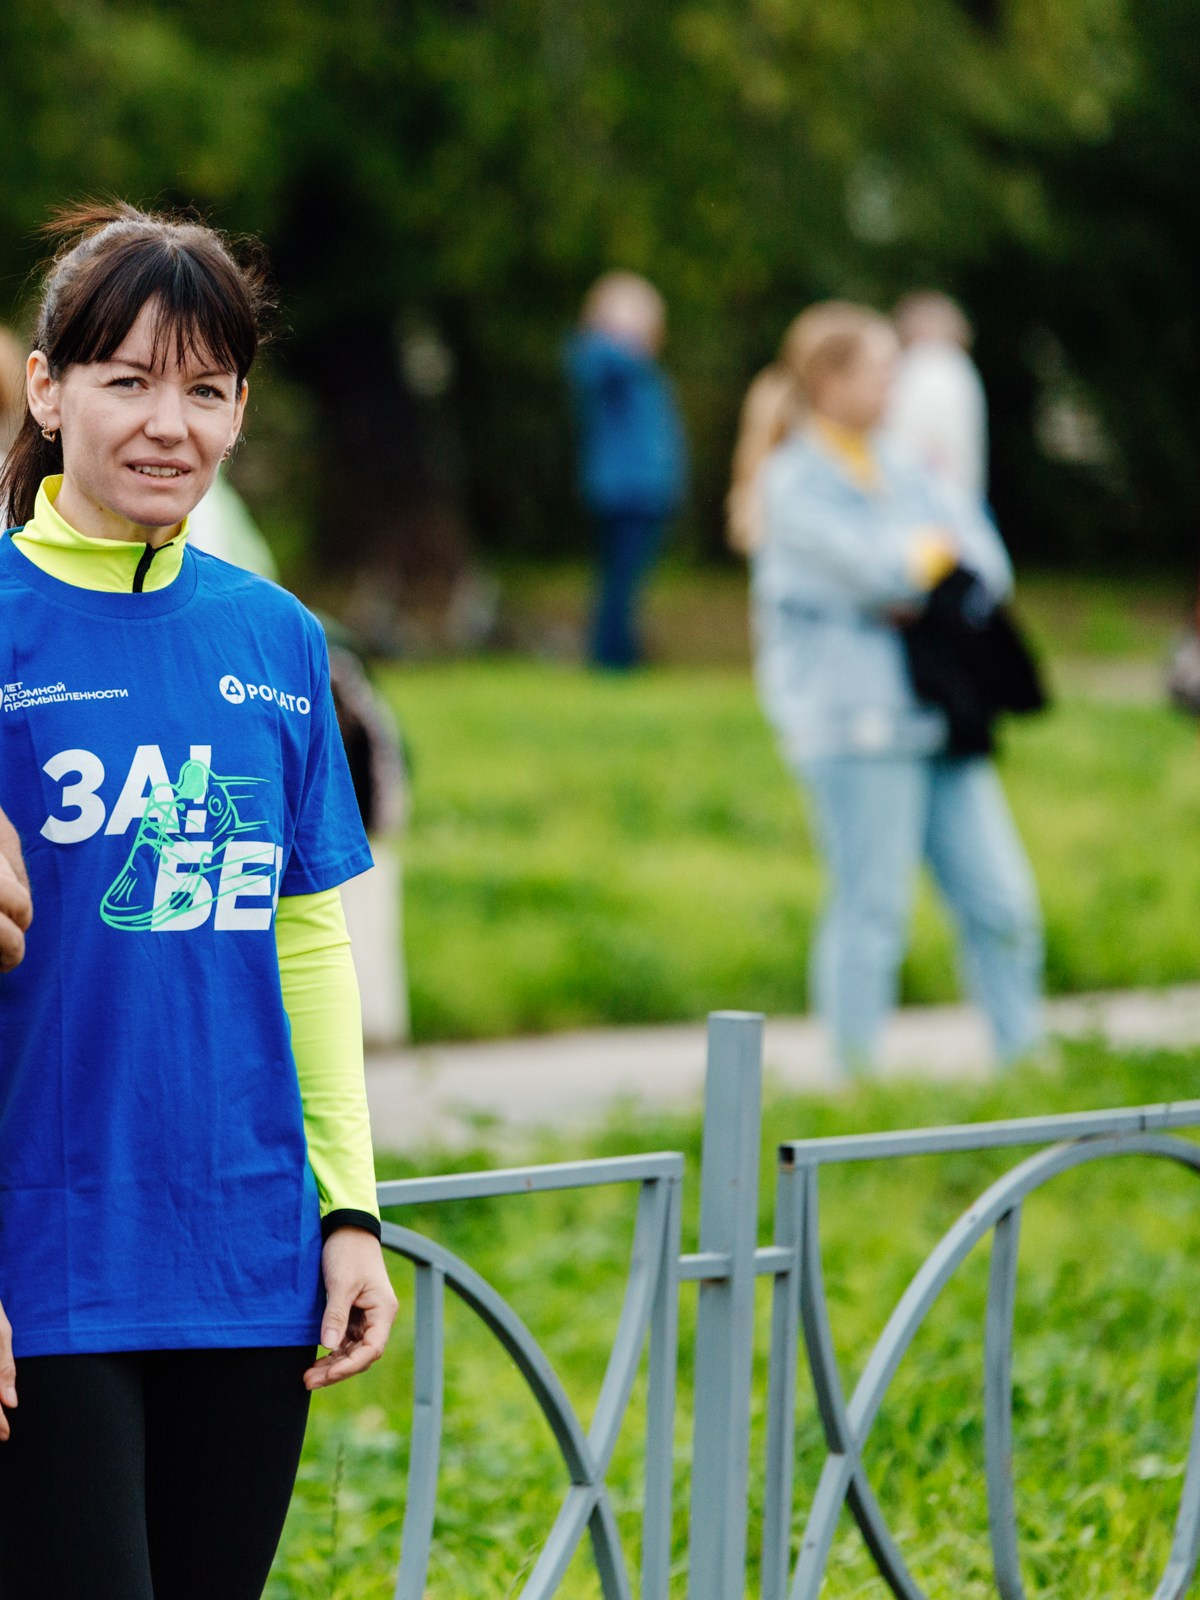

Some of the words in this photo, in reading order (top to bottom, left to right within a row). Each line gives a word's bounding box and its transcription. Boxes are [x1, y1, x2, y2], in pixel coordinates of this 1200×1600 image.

[3, 682, 23, 693] ЛЕТ
[3, 682, 66, 703] АТОМНОЙ
[4, 689, 129, 712] ПРОМЫШЛЕННОСТИ
[40, 745, 212, 844] ЗА!
[151, 841, 283, 931] БЕ
